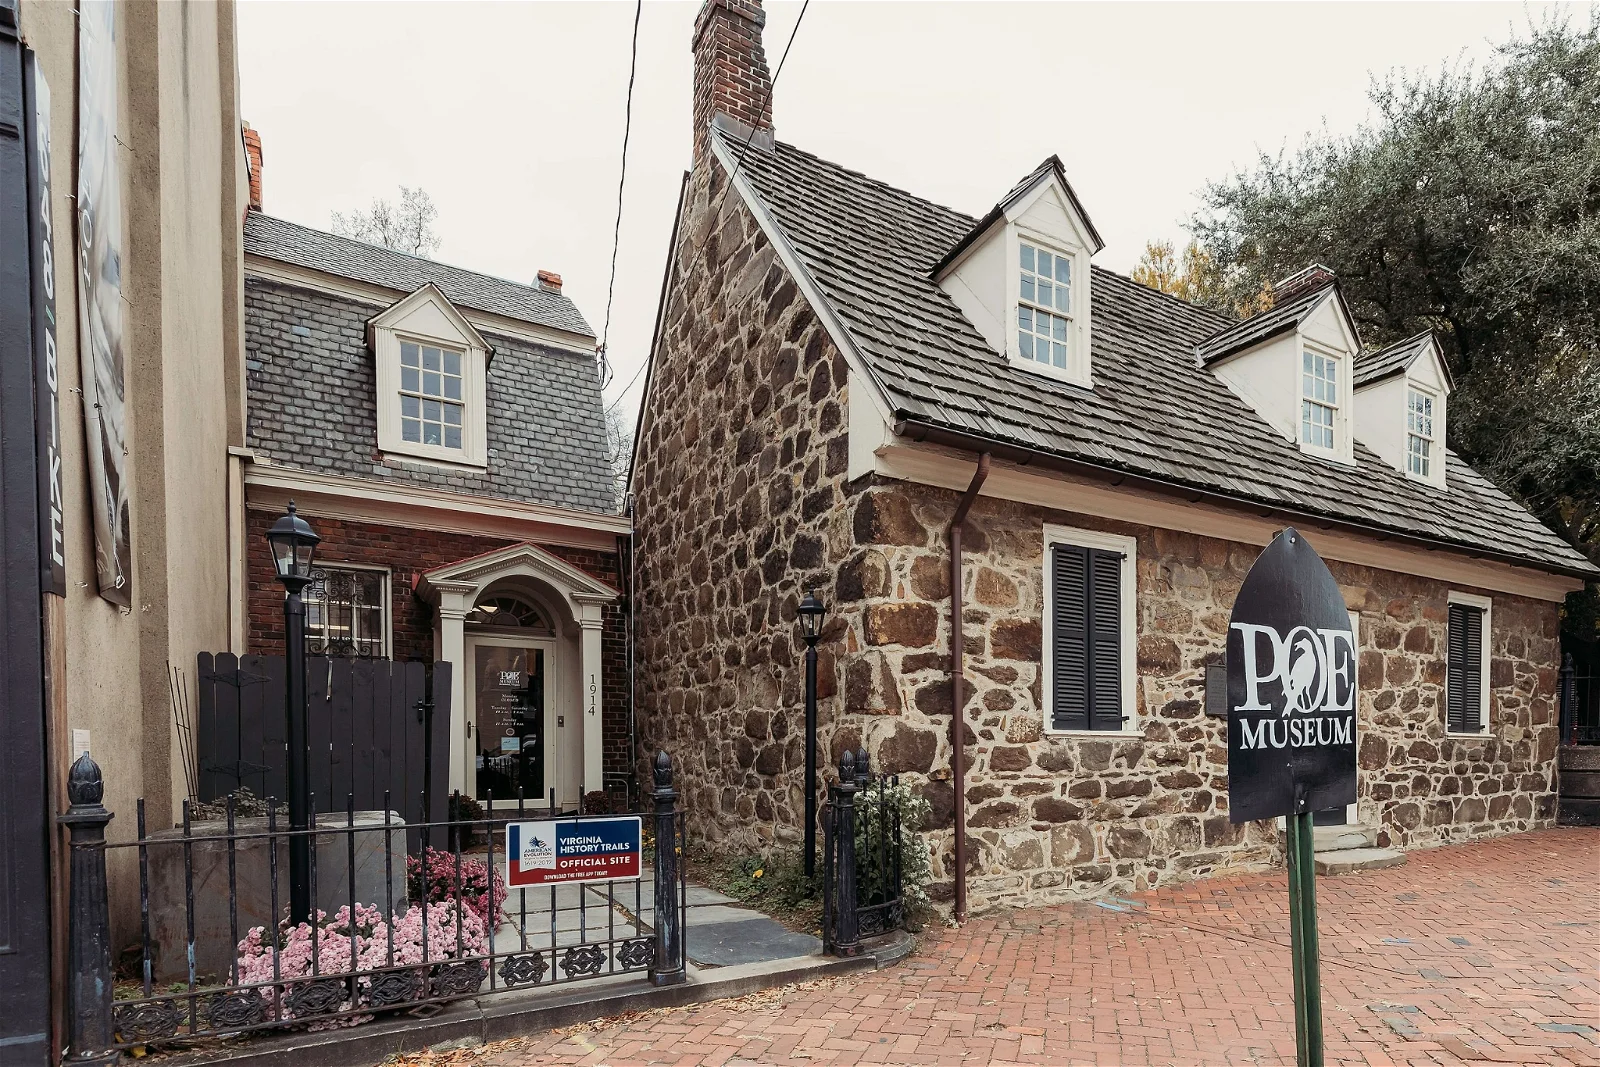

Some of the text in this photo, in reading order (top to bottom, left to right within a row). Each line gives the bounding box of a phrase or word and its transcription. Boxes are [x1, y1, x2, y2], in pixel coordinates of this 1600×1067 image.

[1230, 622, 1356, 717] POE
[588, 674, 597, 716] 1914
[1239, 716, 1353, 749] MUSEUM
[560, 836, 602, 845] VIRGINIA
[560, 843, 630, 854] HISTORY TRAILS
[560, 856, 631, 868] OFFICIAL SITE
